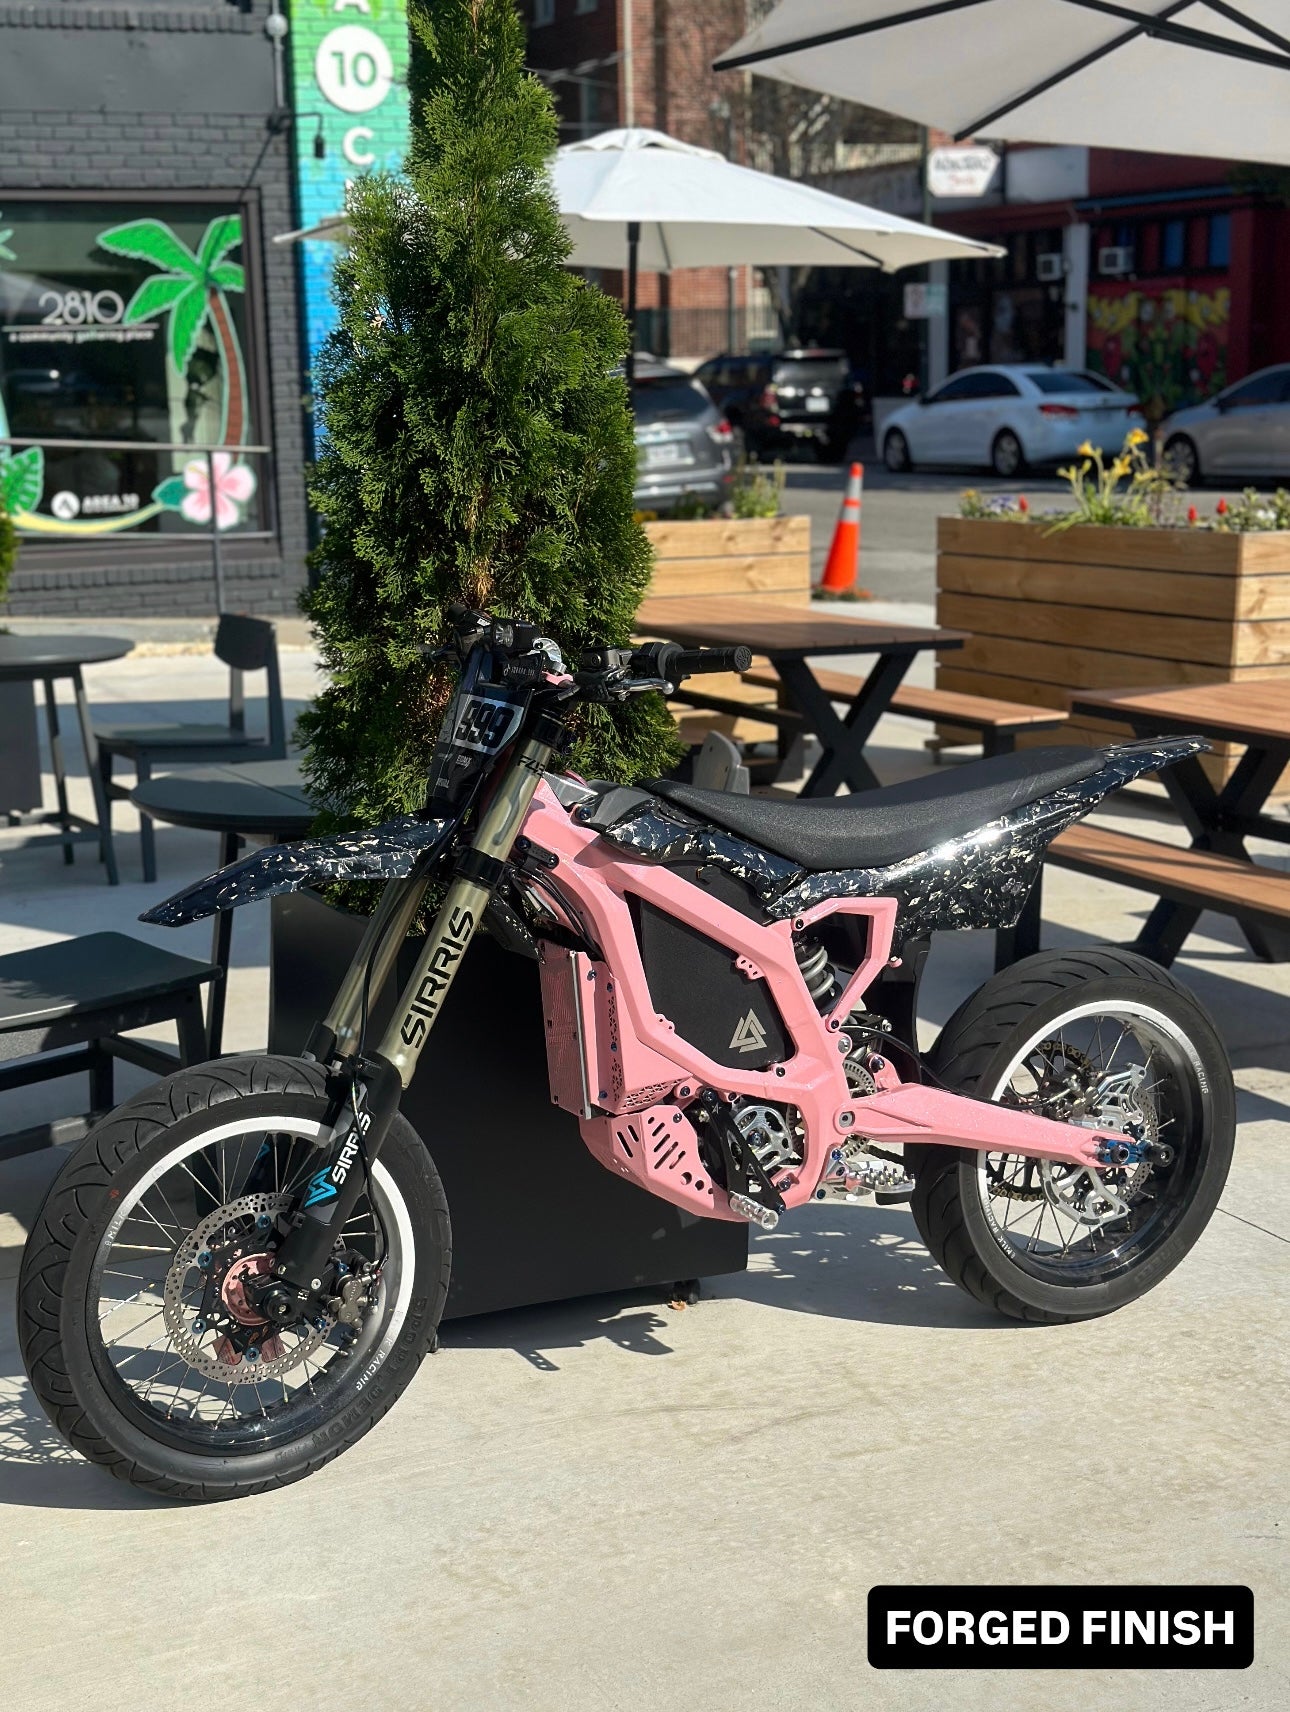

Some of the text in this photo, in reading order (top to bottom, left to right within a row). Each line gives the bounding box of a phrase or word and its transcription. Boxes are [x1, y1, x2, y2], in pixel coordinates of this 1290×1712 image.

[331, 52, 378, 87] 10
[38, 290, 124, 325] 2810
[400, 906, 474, 1049] SIRRIS
[1193, 1060, 1209, 1094] RACING
[331, 1111, 371, 1185] SIRRS
[355, 1351, 386, 1391] RACING
